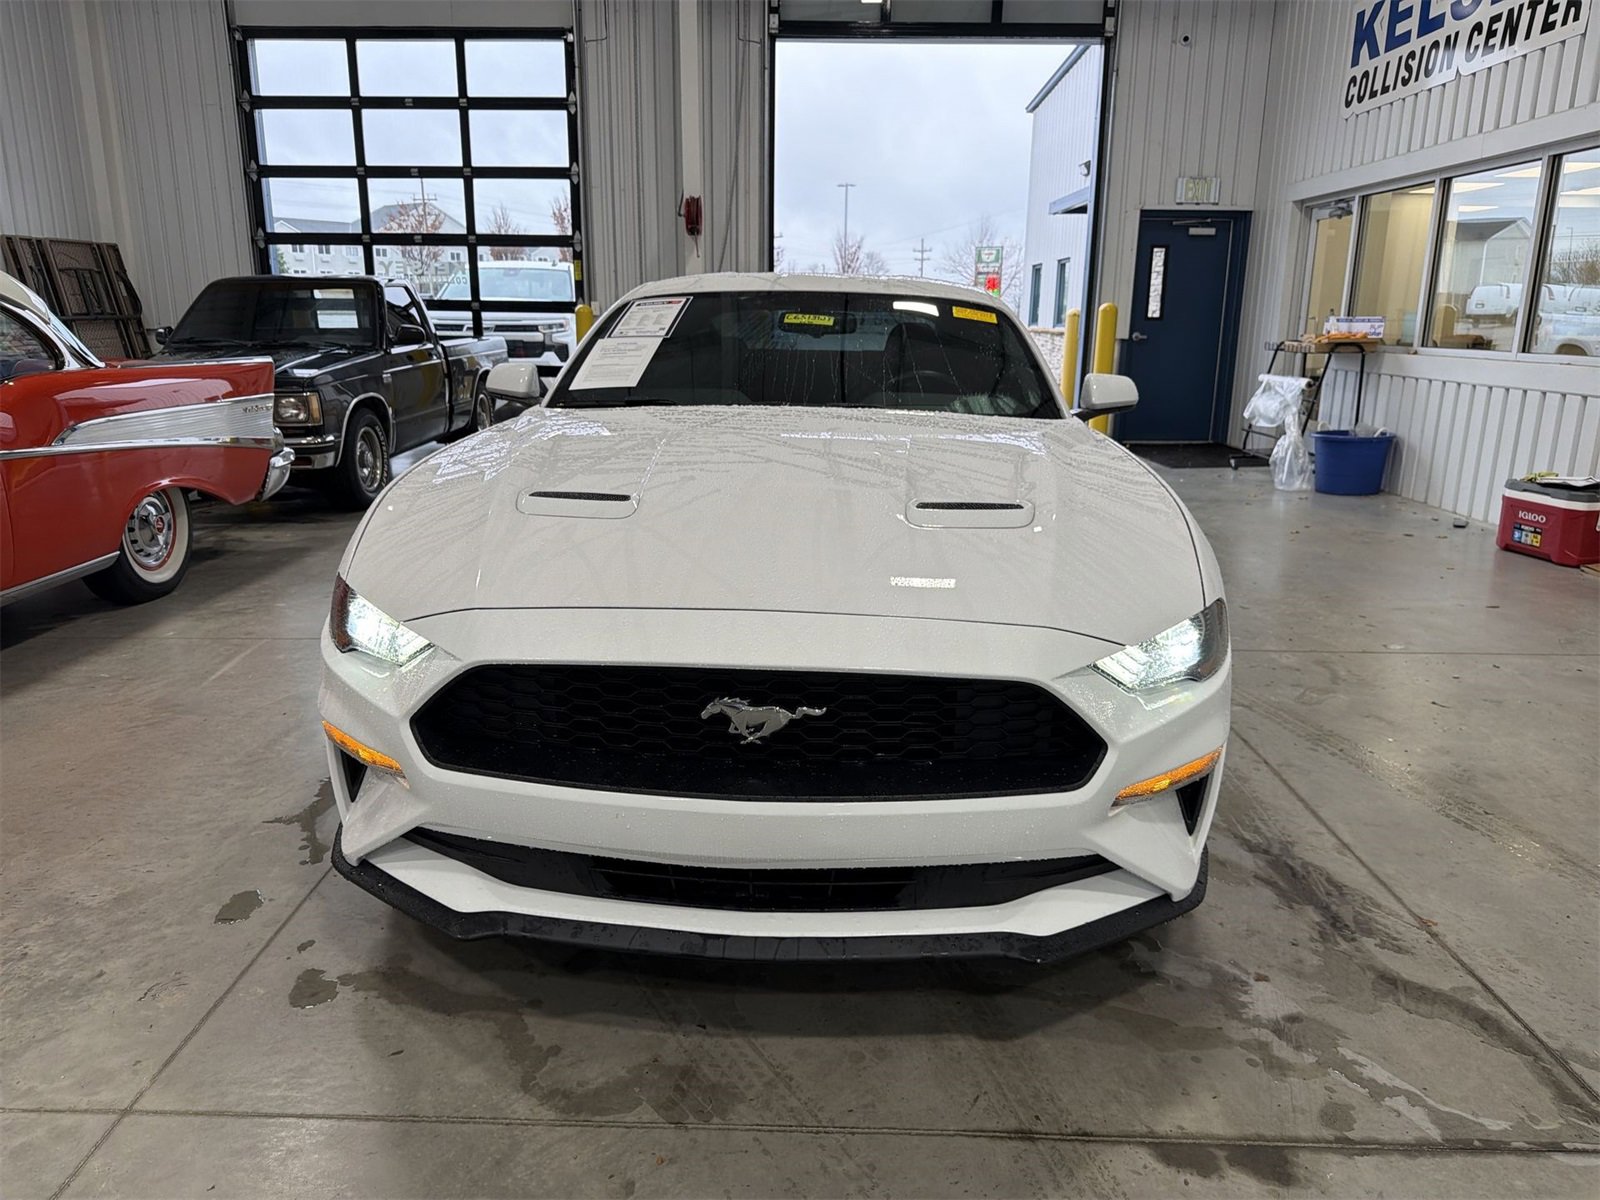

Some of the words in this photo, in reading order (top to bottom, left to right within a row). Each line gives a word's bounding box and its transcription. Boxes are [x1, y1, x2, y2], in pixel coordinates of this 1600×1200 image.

[1344, 31, 1460, 109] COLLISION
[1464, 0, 1583, 63] CENTER
[1350, 0, 1500, 68] KEL
[1184, 178, 1212, 201] EXIT
[1518, 510, 1547, 523] IGLOO
